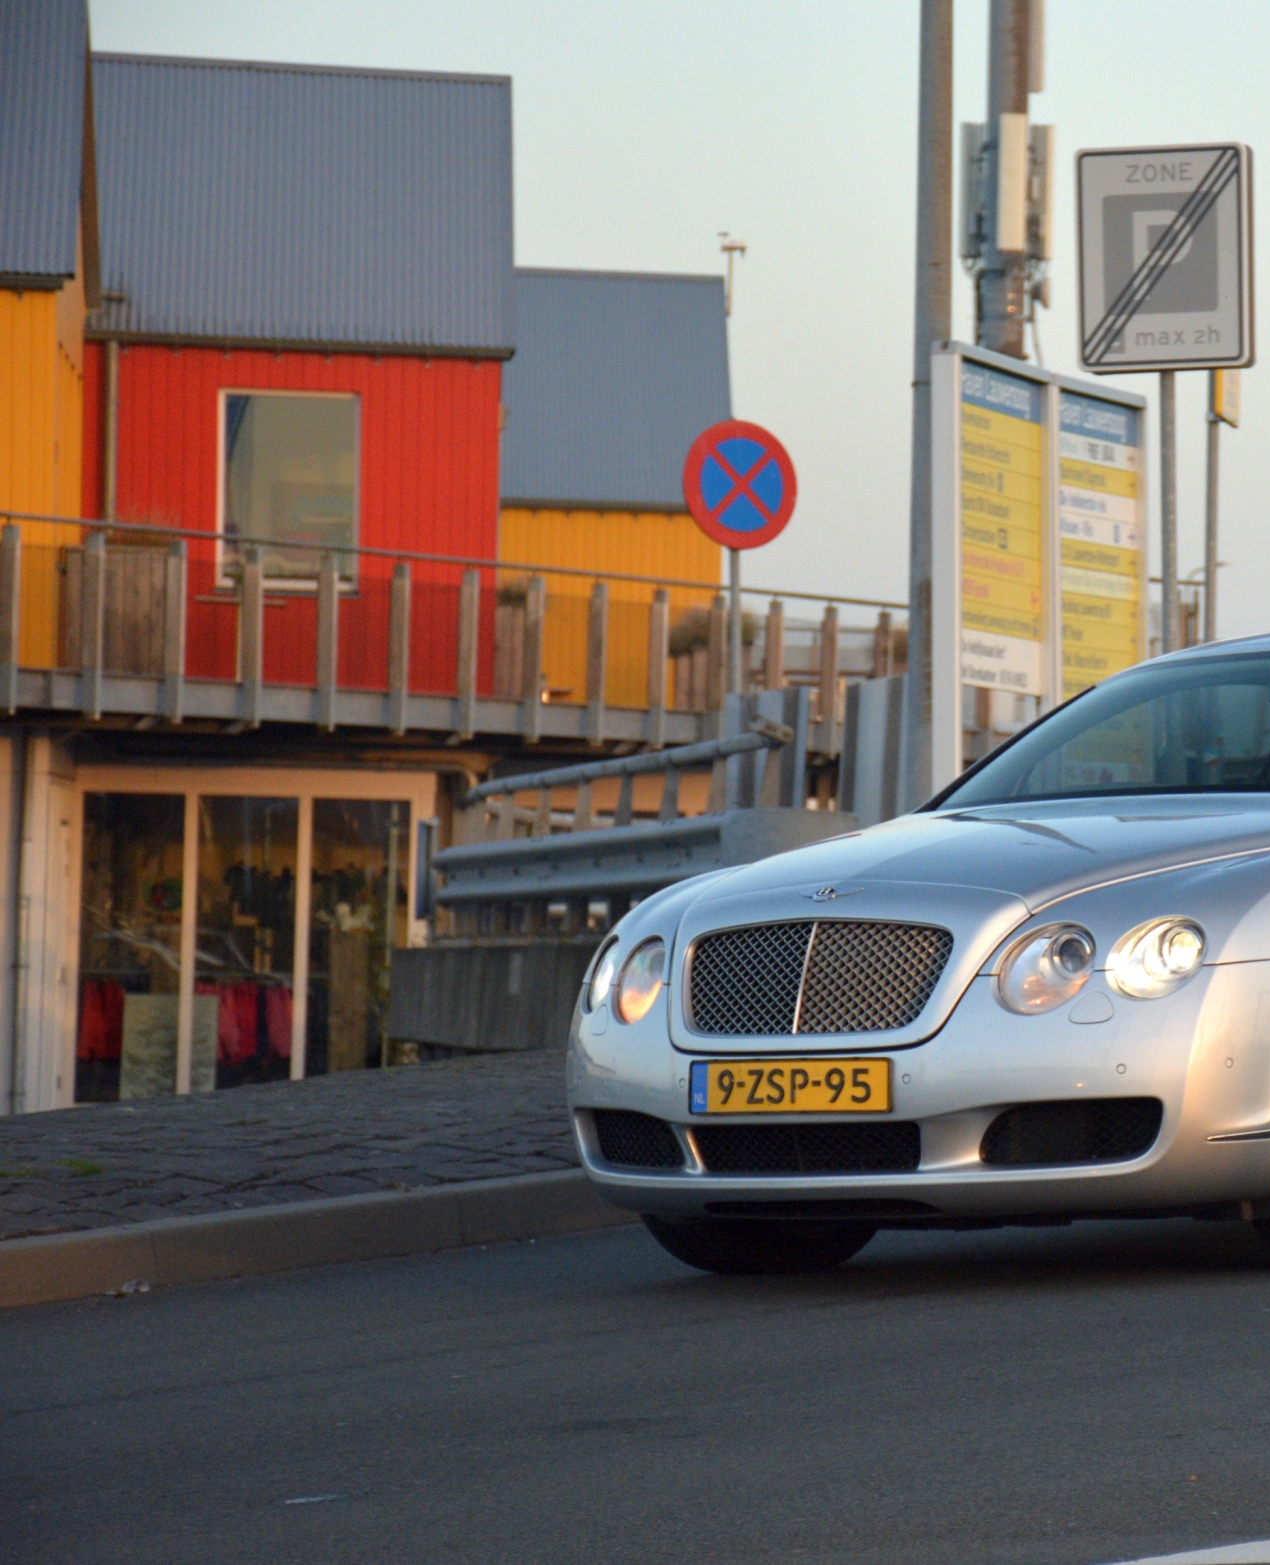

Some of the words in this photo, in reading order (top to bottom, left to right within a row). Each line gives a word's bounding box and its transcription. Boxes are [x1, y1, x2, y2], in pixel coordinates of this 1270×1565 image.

[1125, 162, 1193, 183] ZONE
[1135, 330, 1185, 346] max
[1194, 324, 1220, 344] 2h
[717, 1068, 871, 1105] 9-ZSP-95
[693, 1093, 705, 1105] NL
